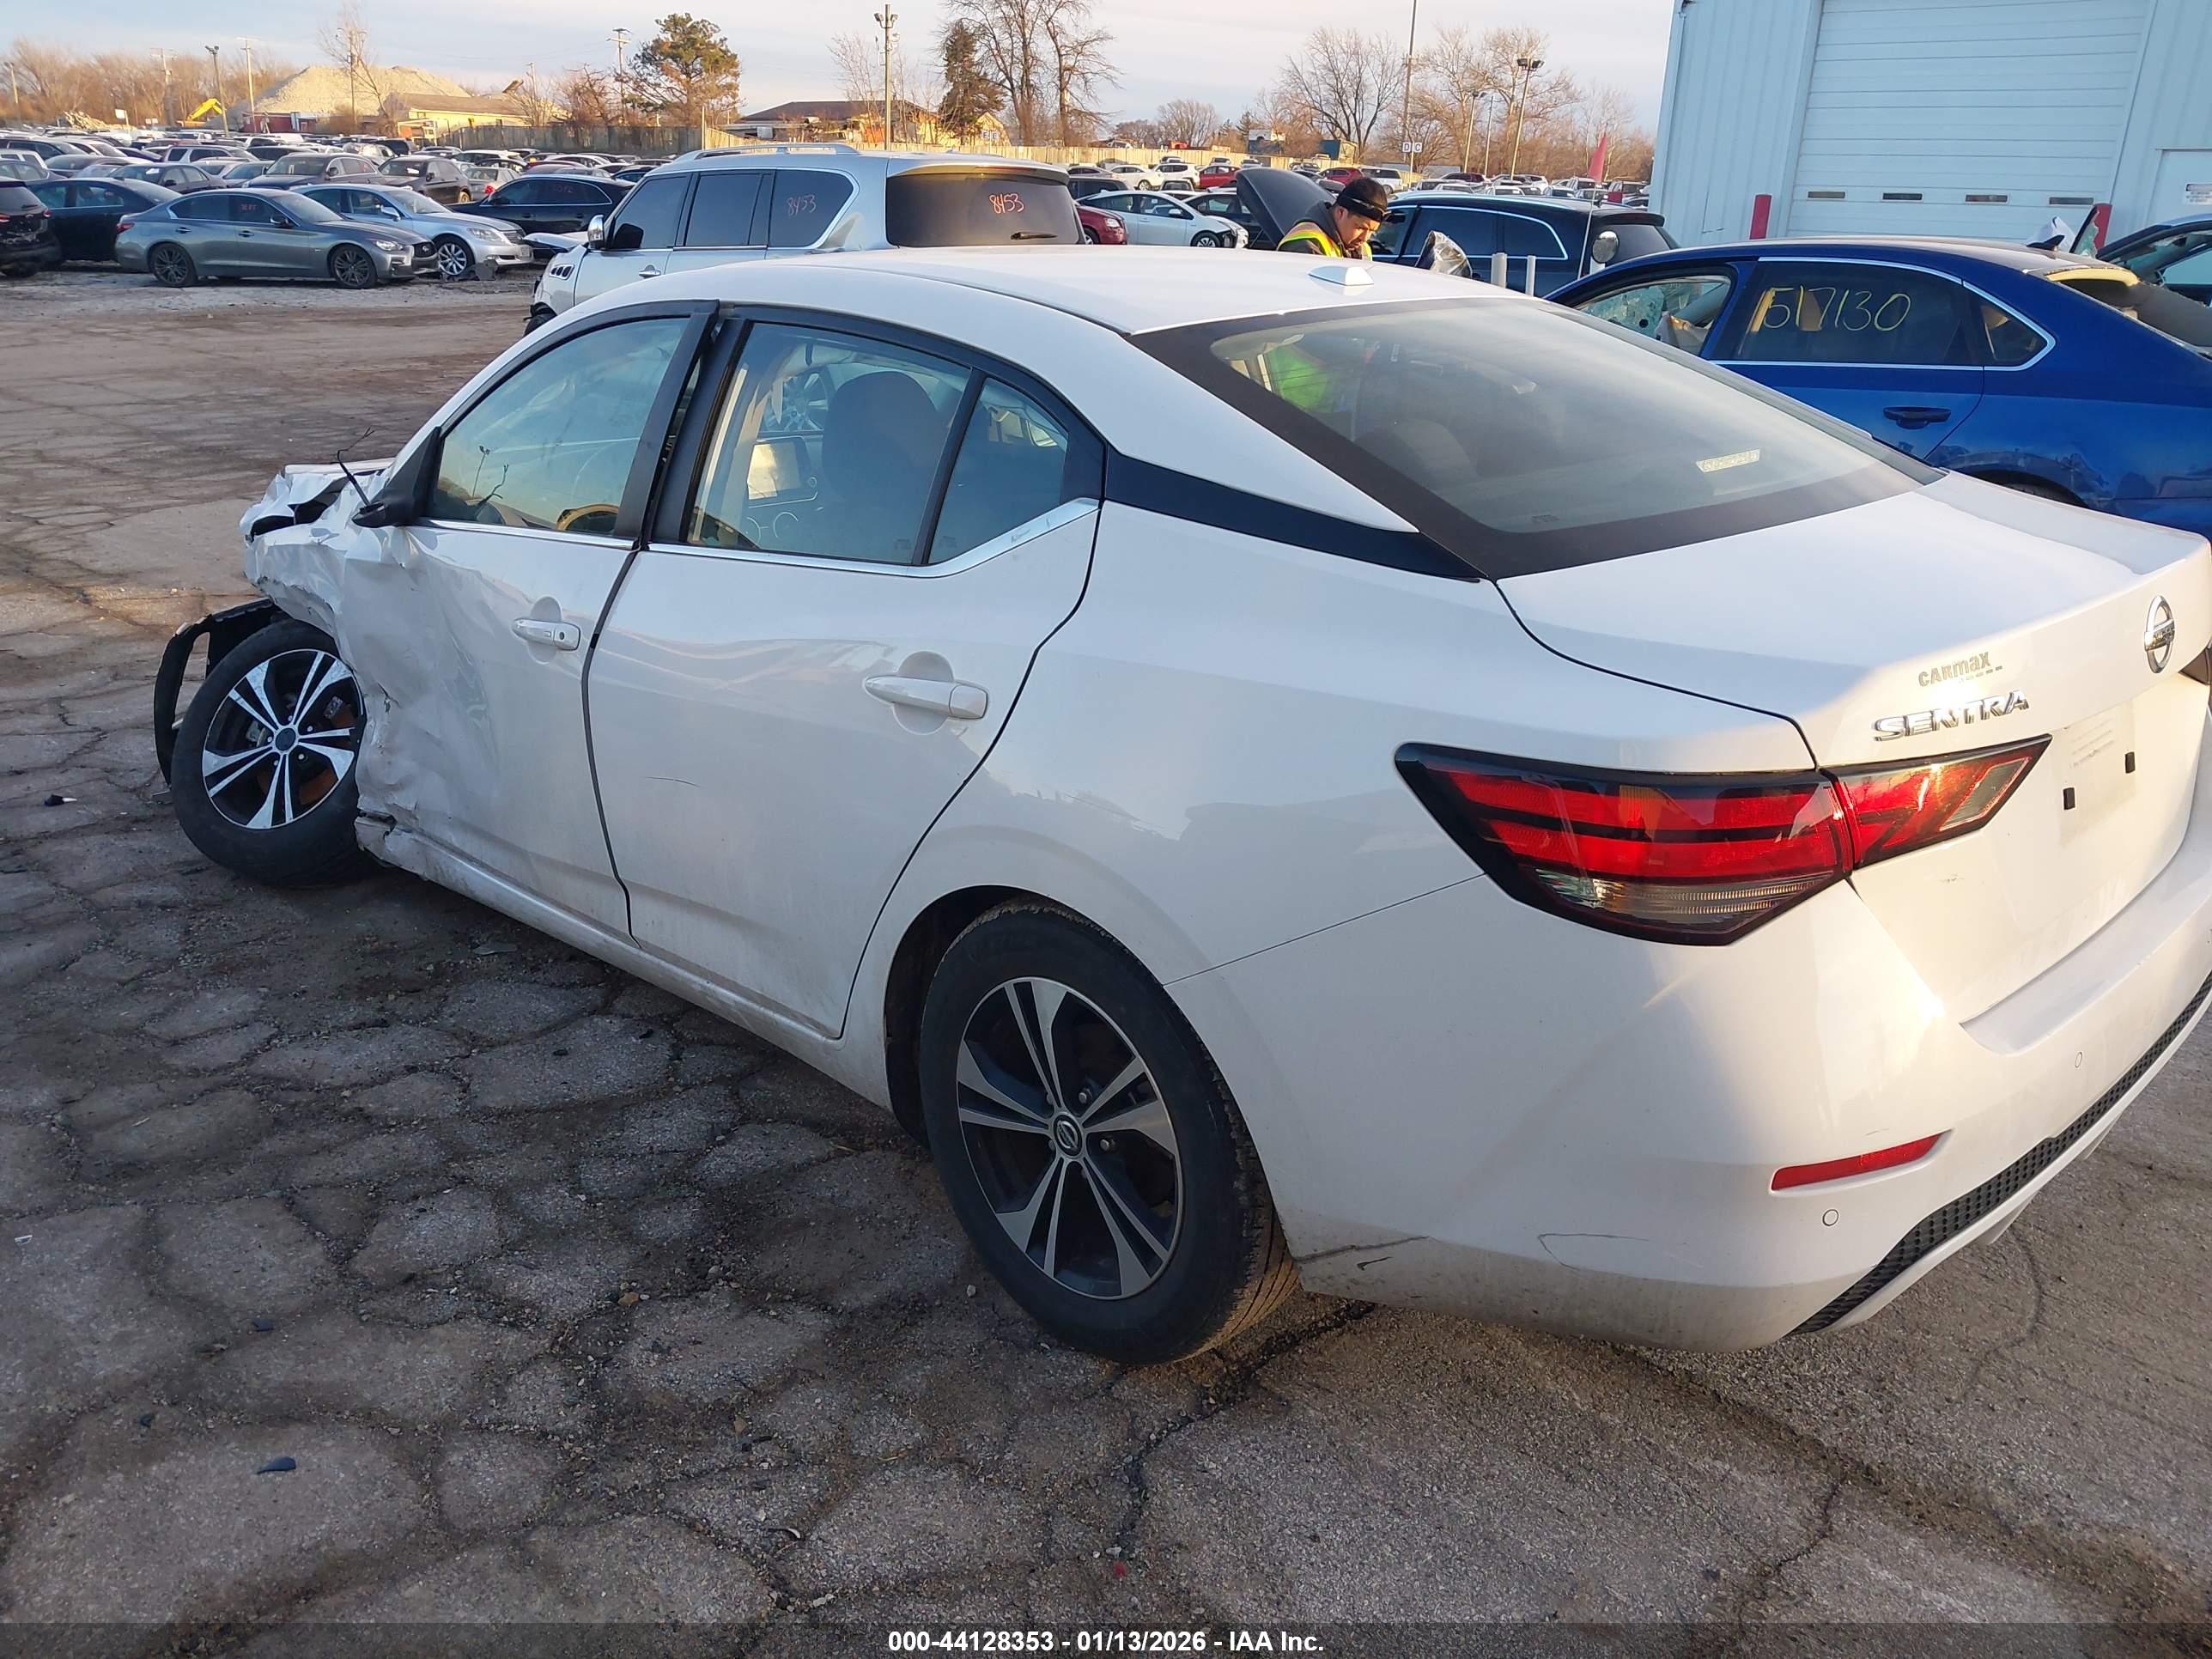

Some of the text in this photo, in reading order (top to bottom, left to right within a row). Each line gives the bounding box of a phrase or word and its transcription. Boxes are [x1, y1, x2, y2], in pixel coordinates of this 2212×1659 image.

[787, 194, 817, 216] 8453
[989, 193, 1024, 214] 8453
[1874, 690, 2030, 741] SENTRA
